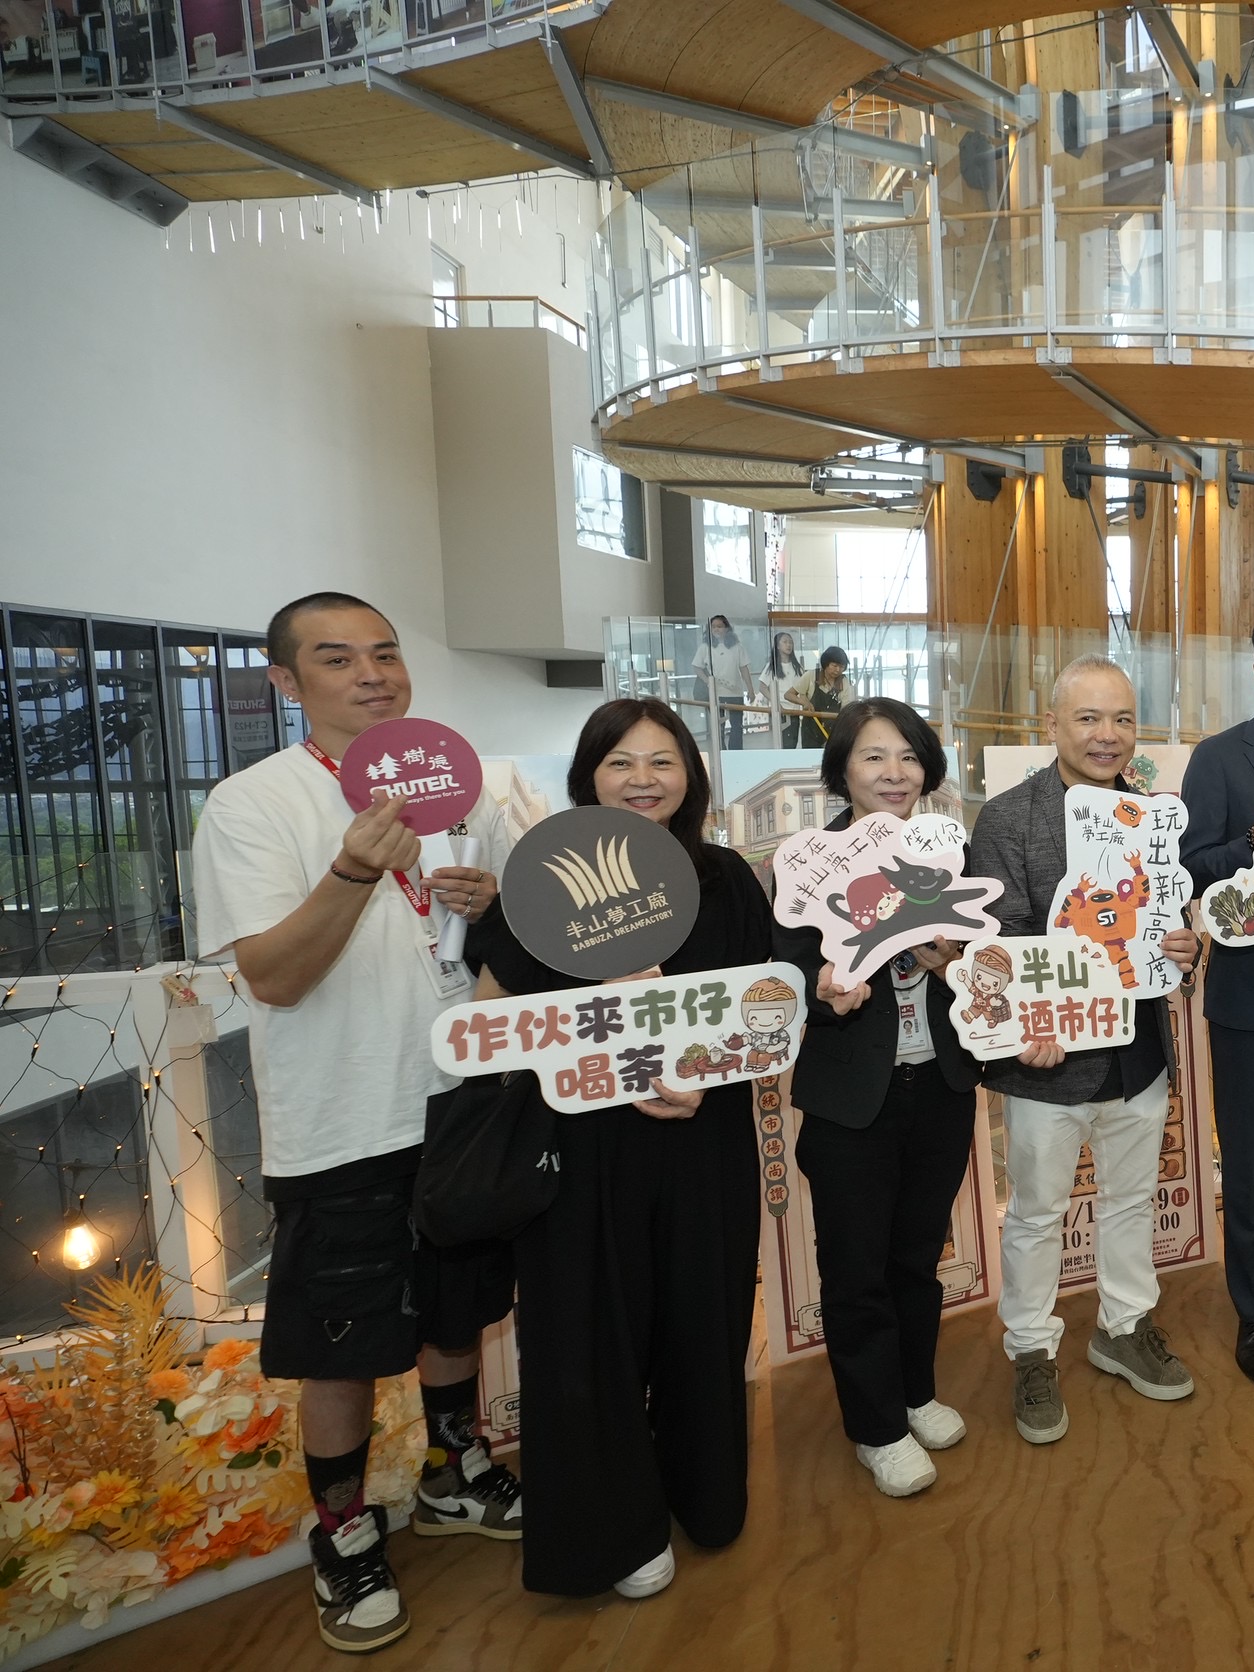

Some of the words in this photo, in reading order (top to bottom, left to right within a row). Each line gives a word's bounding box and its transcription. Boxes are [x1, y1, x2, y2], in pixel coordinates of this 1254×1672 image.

[783, 836, 827, 871] 我在
[903, 822, 963, 853] 等你
[566, 891, 670, 939] 半山夢工廠
[1097, 910, 1116, 926] ST
[1143, 806, 1186, 989] 玩出新高度
[571, 932, 614, 952] BABBUZA
[613, 909, 674, 937] DREAMFACTORY
[1020, 947, 1089, 994] 半山
[446, 981, 733, 1063] 作伙來市仔
[554, 1044, 666, 1101] 喝茶
